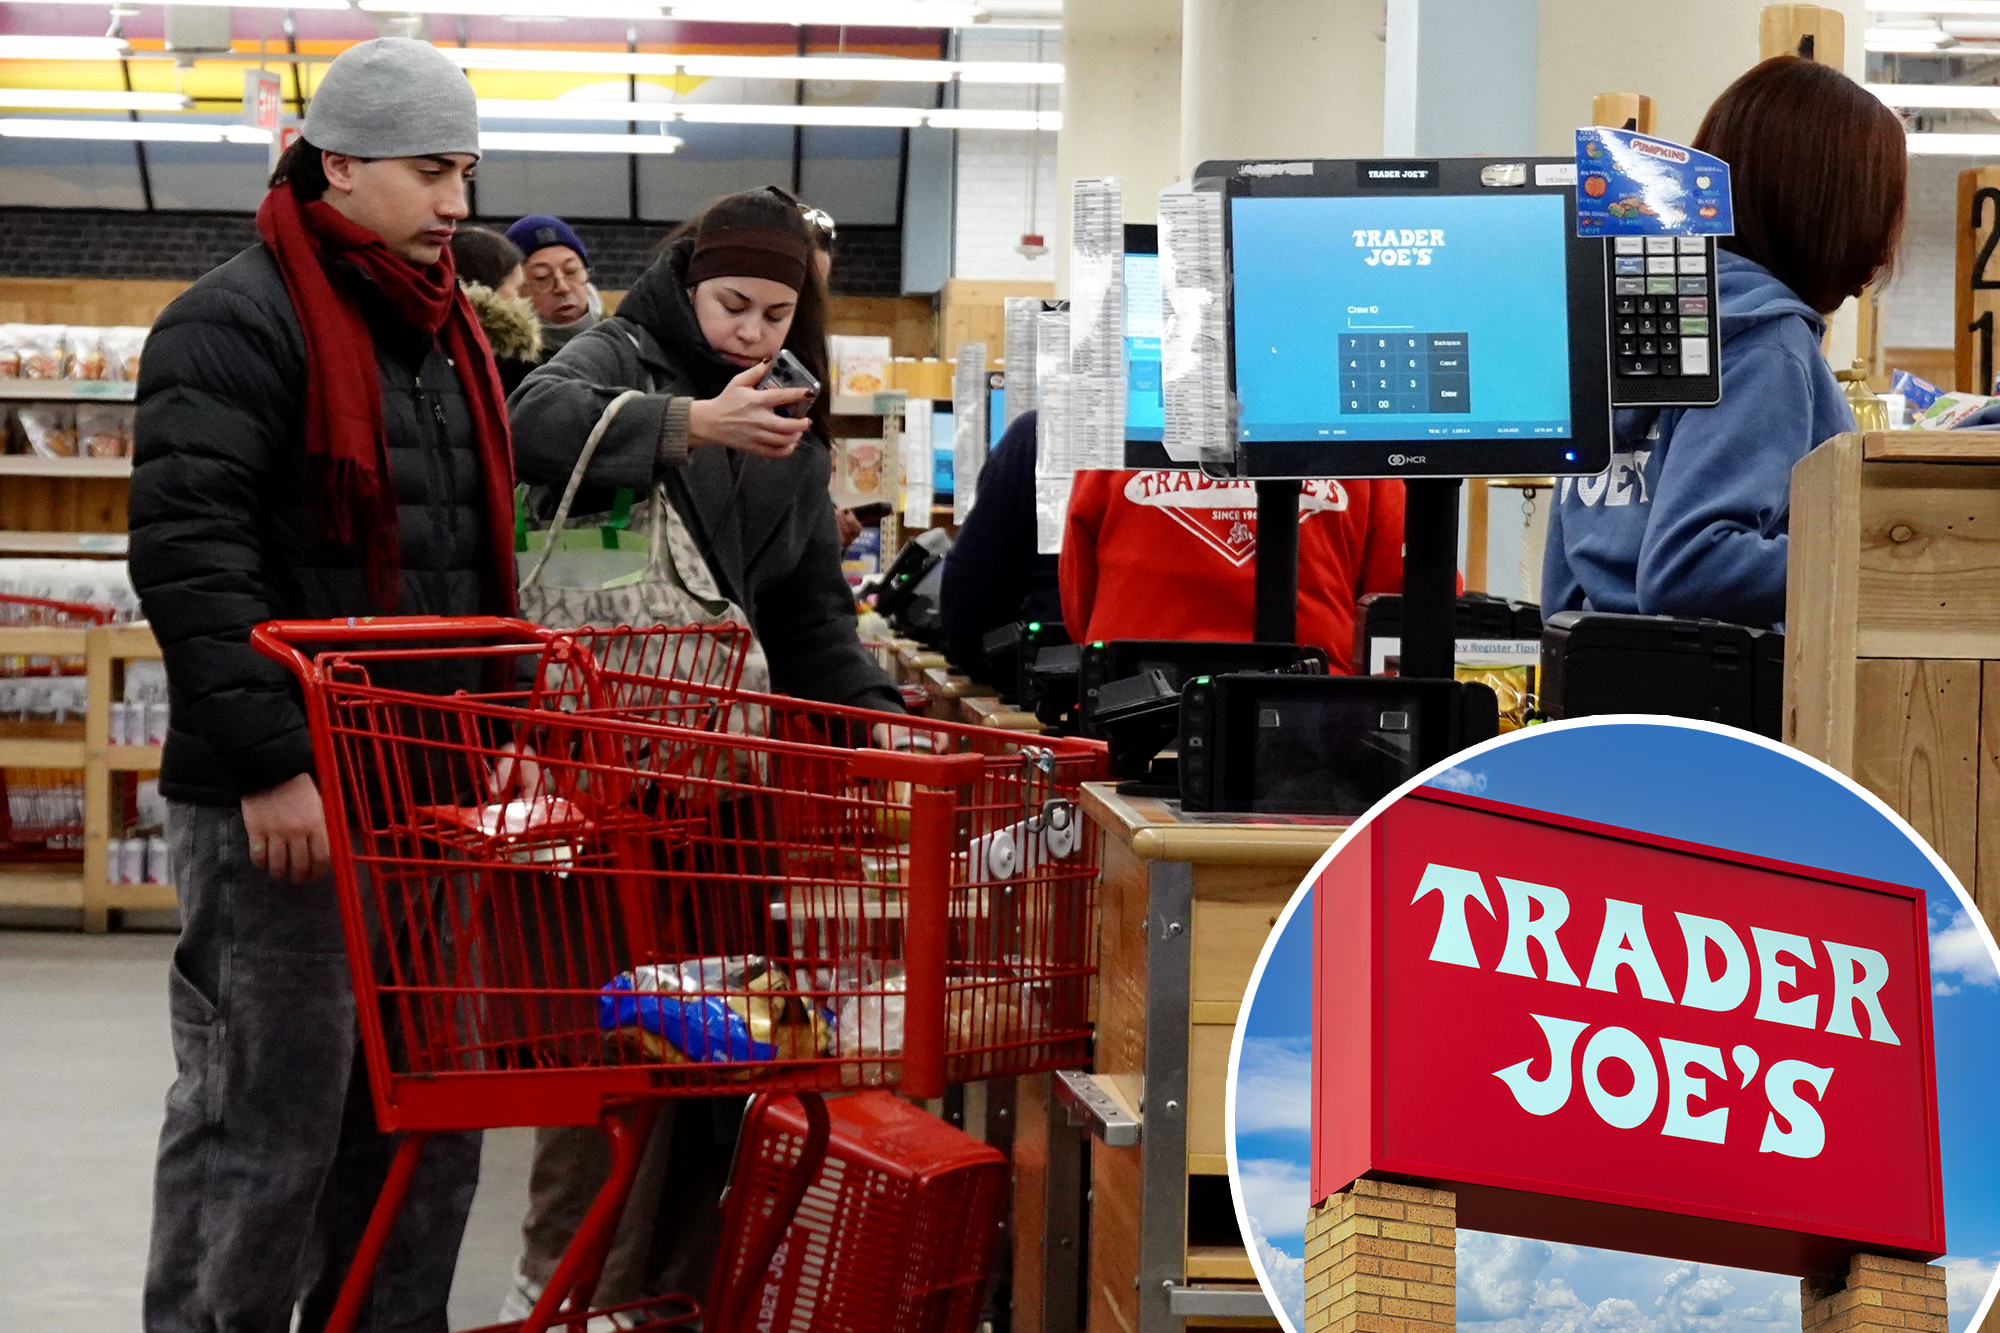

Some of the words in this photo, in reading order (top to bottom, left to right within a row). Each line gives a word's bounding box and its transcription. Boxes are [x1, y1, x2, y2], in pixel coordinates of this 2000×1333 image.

[1632, 139, 1687, 163] PUMPKINS
[1368, 170, 1401, 179] TRADER
[1351, 229, 1446, 247] TRADER
[1971, 186, 2000, 290] 2
[1363, 248, 1434, 267] JOE'S
[1347, 306, 1369, 314] Crew
[1369, 306, 1379, 314] ID
[1623, 301, 1629, 309] 7
[1644, 301, 1650, 309] 8
[1665, 301, 1671, 310] 9
[1624, 322, 1630, 330] 4
[1645, 321, 1651, 329] 5
[1666, 321, 1672, 329] 6
[1350, 340, 1356, 348] 7
[1379, 339, 1385, 348] 8
[1408, 339, 1415, 348] 9
[1434, 339, 1461, 347] Backspace
[1624, 342, 1629, 350] 1
[1645, 342, 1651, 350] 2
[1666, 342, 1673, 350] 3
[1968, 310, 1993, 396] 1
[1350, 360, 1357, 369] 4
[1379, 360, 1386, 368] 5
[1409, 360, 1416, 368] 6
[1635, 362, 1642, 371] 0
[1351, 380, 1356, 389] 1
[1380, 380, 1386, 389] 2
[1409, 380, 1416, 388] 3
[1351, 401, 1358, 409] 0
[1378, 400, 1389, 409] 00
[1406, 455, 1427, 464] NCR
[1211, 510, 1240, 521] SINCE
[1470, 643, 1511, 654] Register
[1515, 643, 1539, 654] Tips!
[1410, 862, 1902, 1046] TRADER
[1491, 1012, 1835, 1159] JOE'S
